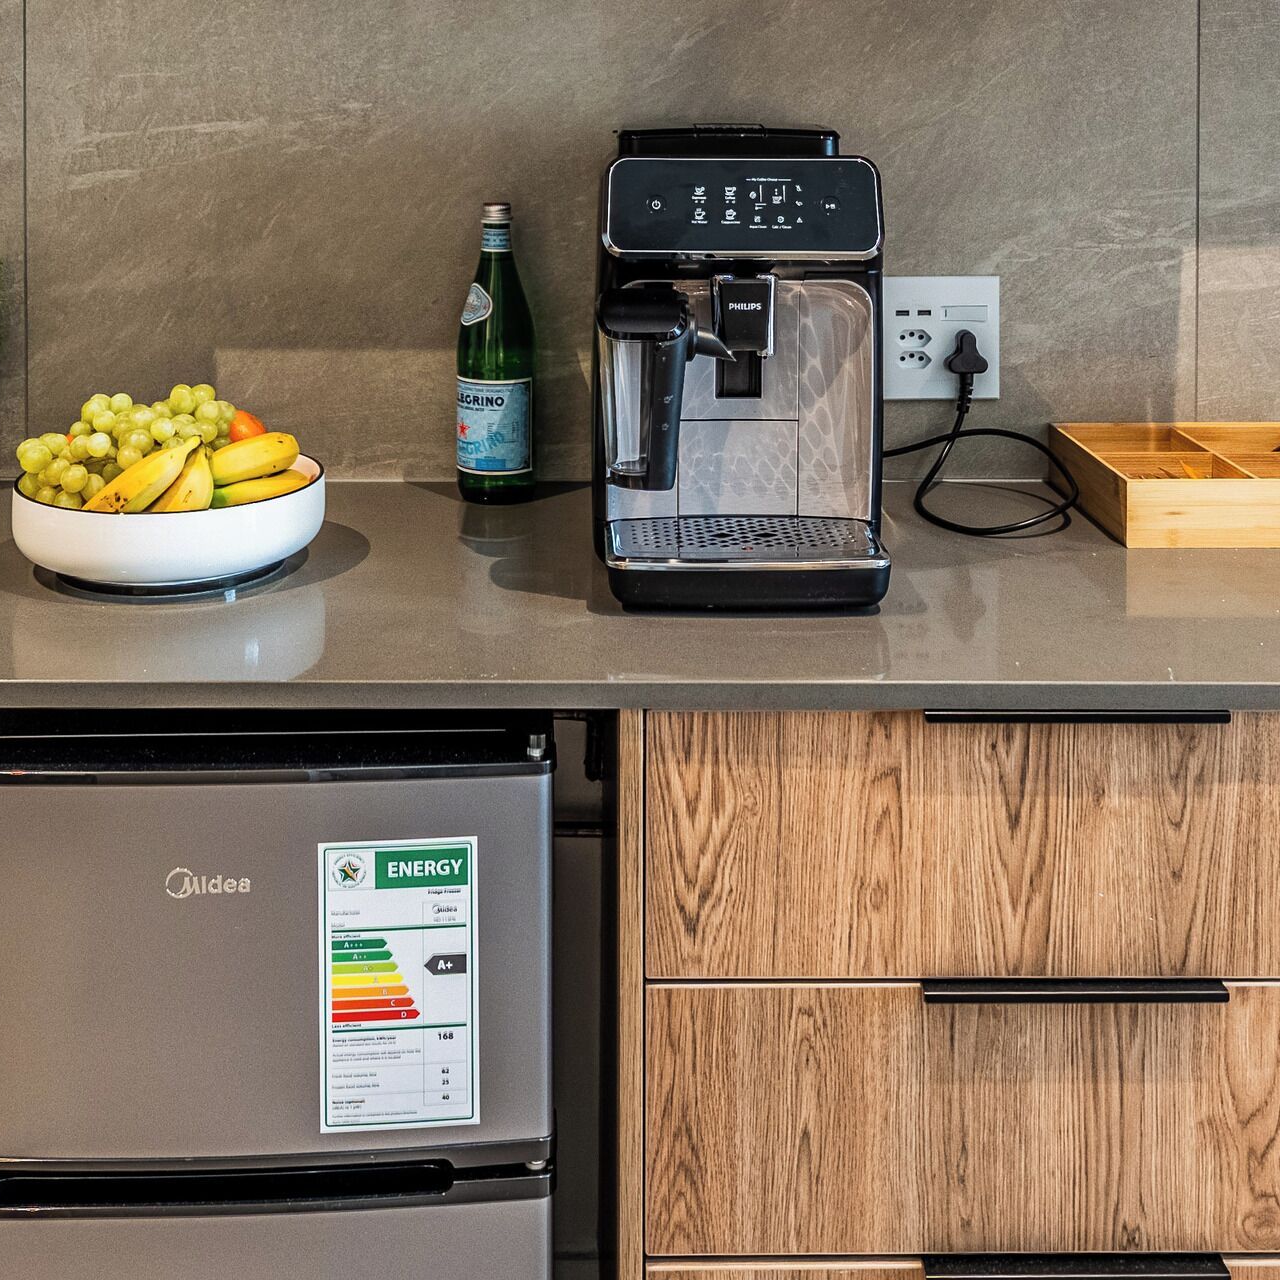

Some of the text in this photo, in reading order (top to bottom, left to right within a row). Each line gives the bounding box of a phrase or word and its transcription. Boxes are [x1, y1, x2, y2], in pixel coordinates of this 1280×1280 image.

[387, 858, 463, 878] ENERGY
[165, 867, 251, 899] Midea
[437, 960, 453, 971] A+
[390, 999, 396, 1007] C
[437, 1032, 455, 1041] 168
